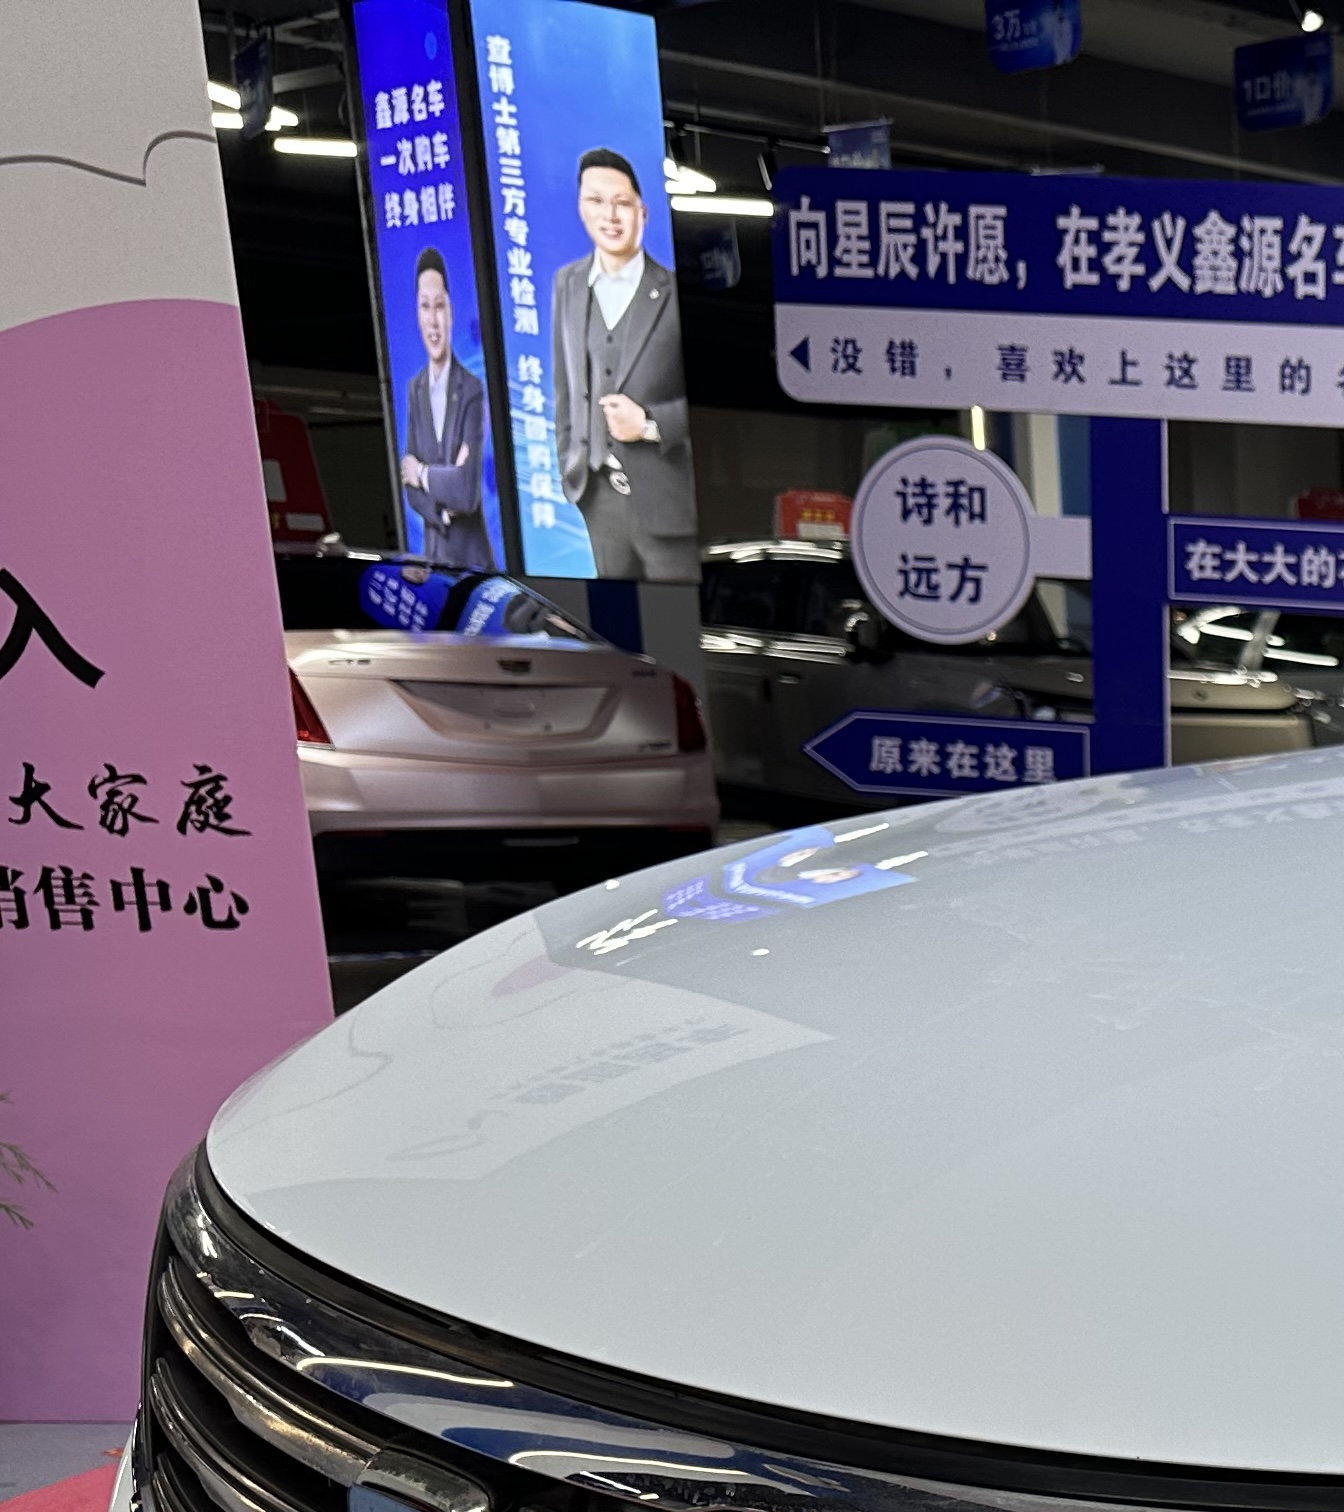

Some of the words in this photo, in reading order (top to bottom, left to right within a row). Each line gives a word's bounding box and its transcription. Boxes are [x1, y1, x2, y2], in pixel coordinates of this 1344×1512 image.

[375, 79, 445, 130] 鑫源名车
[380, 130, 450, 176] 一次购车
[385, 181, 455, 229] 终身相伴
[895, 477, 988, 528] 诗和
[896, 557, 989, 604] 远方
[868, 736, 1056, 784] 原来在这里
[8, 762, 252, 837] 大家庭
